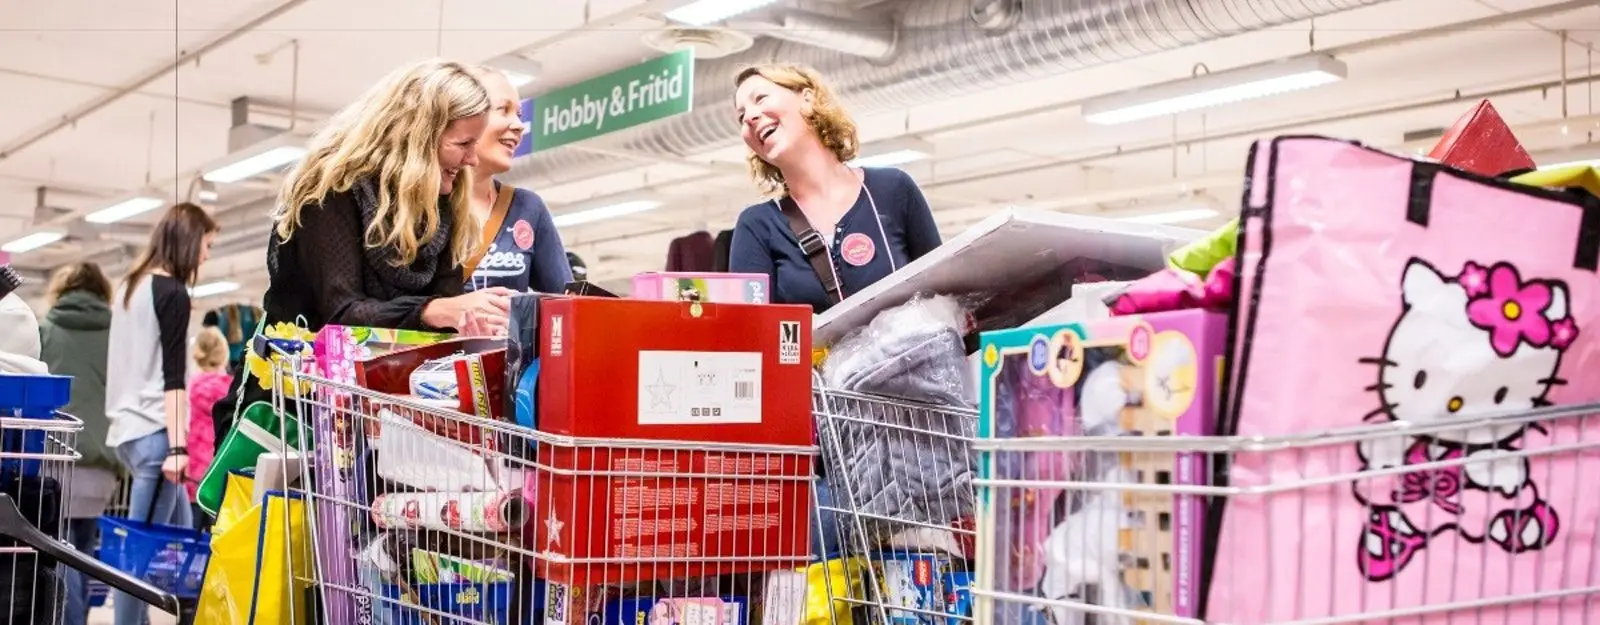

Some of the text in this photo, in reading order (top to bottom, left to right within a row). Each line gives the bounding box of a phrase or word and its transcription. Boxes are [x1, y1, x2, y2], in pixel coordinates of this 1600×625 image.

[543, 64, 684, 136] Hobby & Fritid
